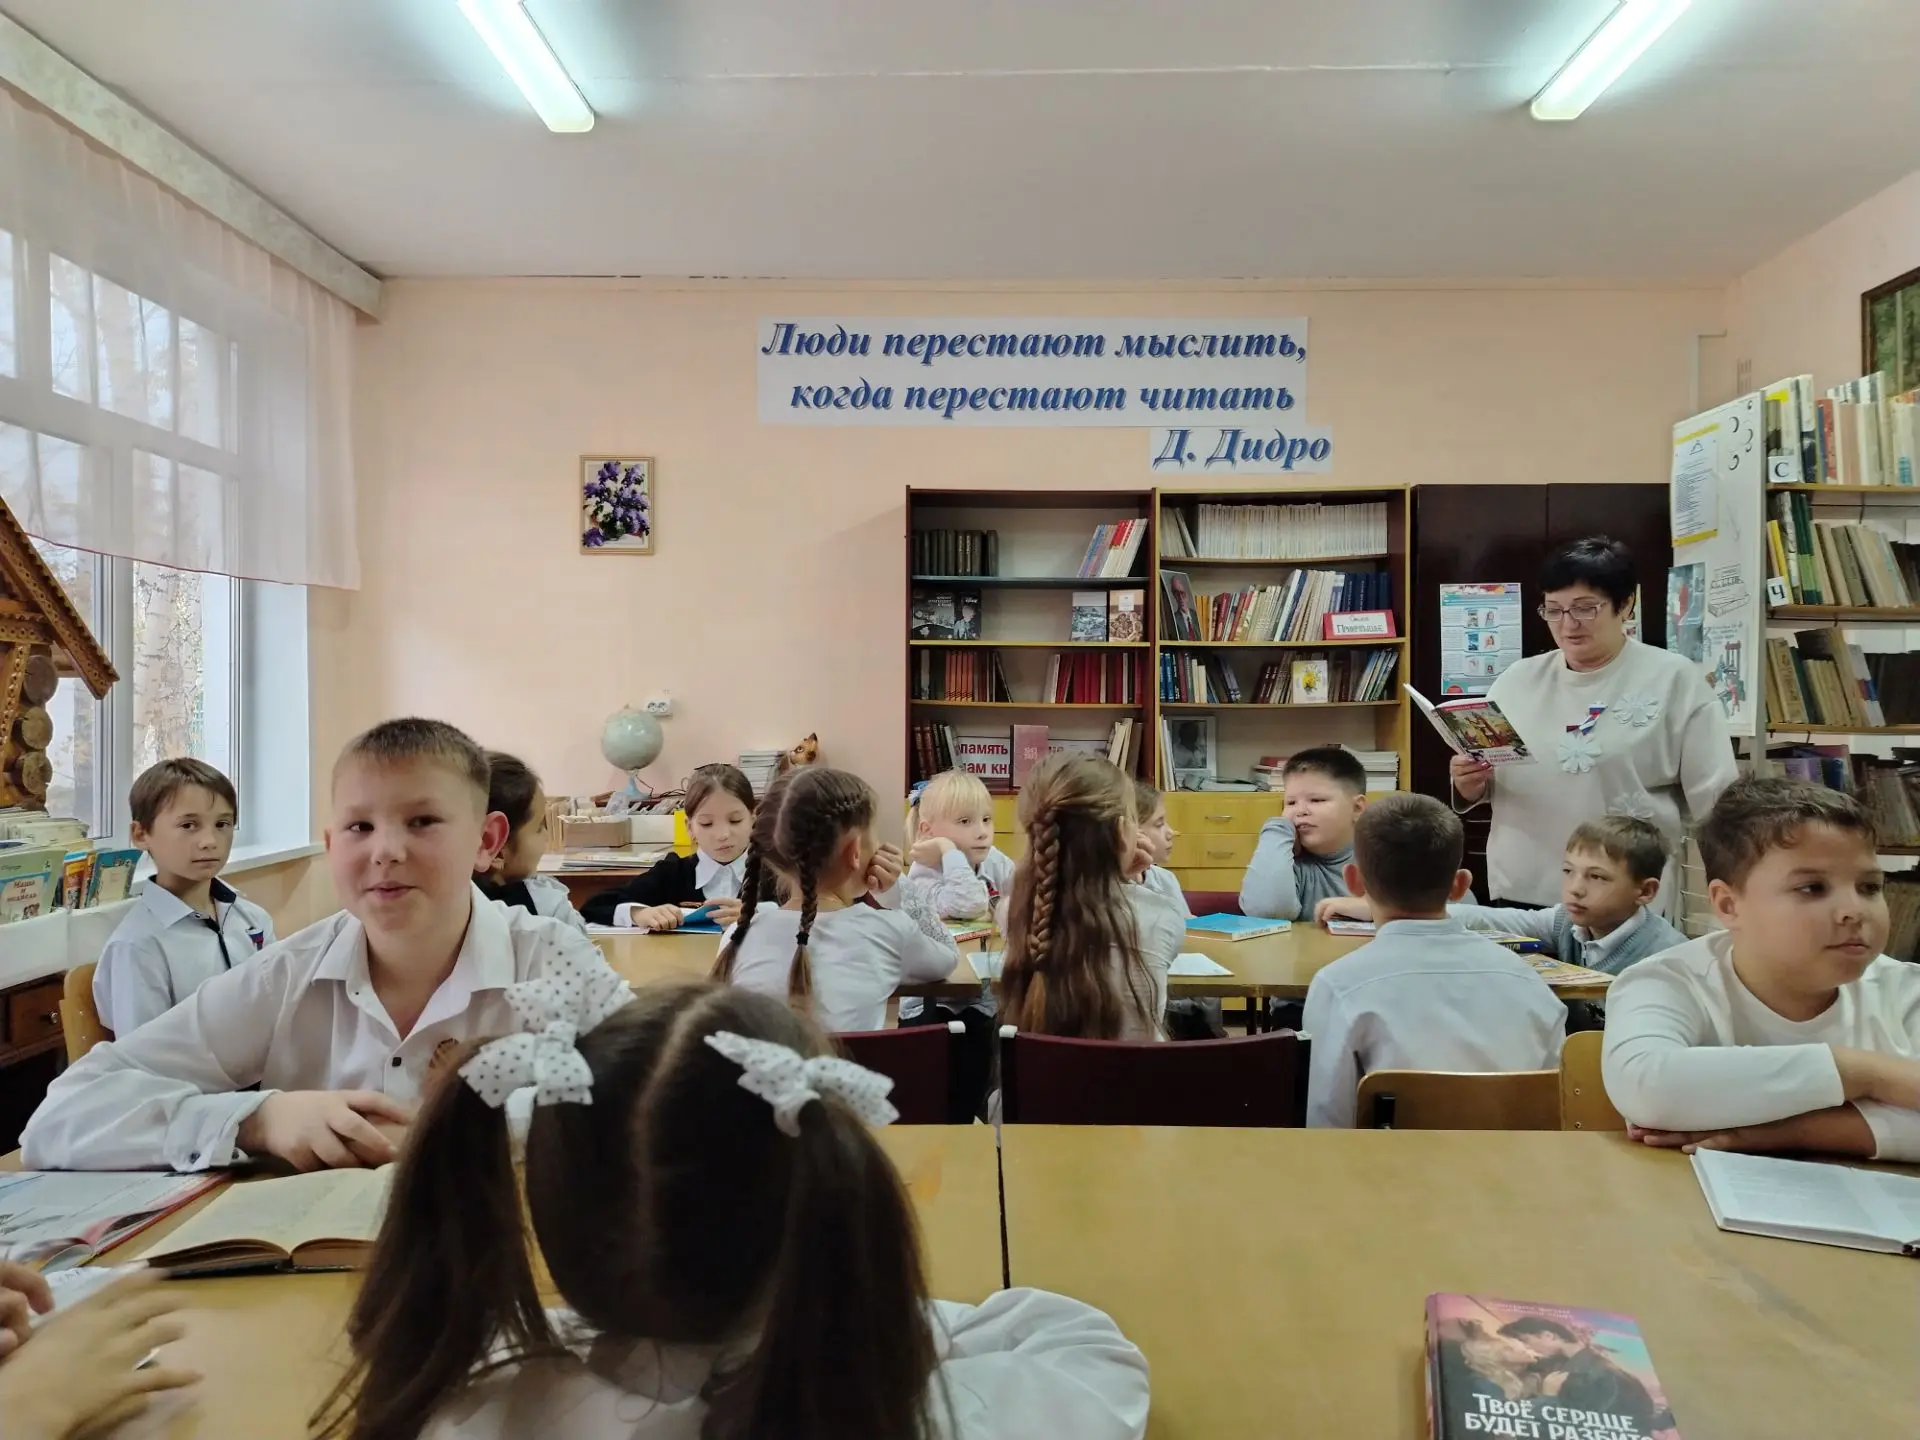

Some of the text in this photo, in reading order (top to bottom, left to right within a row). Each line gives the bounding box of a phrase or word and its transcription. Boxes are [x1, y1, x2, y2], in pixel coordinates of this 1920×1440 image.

[761, 322, 1307, 365] Люди перестают мыслить,
[790, 377, 1296, 420] когда перестают читать
[1153, 427, 1331, 472] Д. Дидро
[1775, 461, 1788, 478] С
[1771, 584, 1785, 599] Ч
[960, 743, 1008, 755] память
[991, 763, 1010, 775] кн
[1464, 1412, 1541, 1439] БУДЕТ
[1541, 1405, 1639, 1433] СЕРДЦЕ
